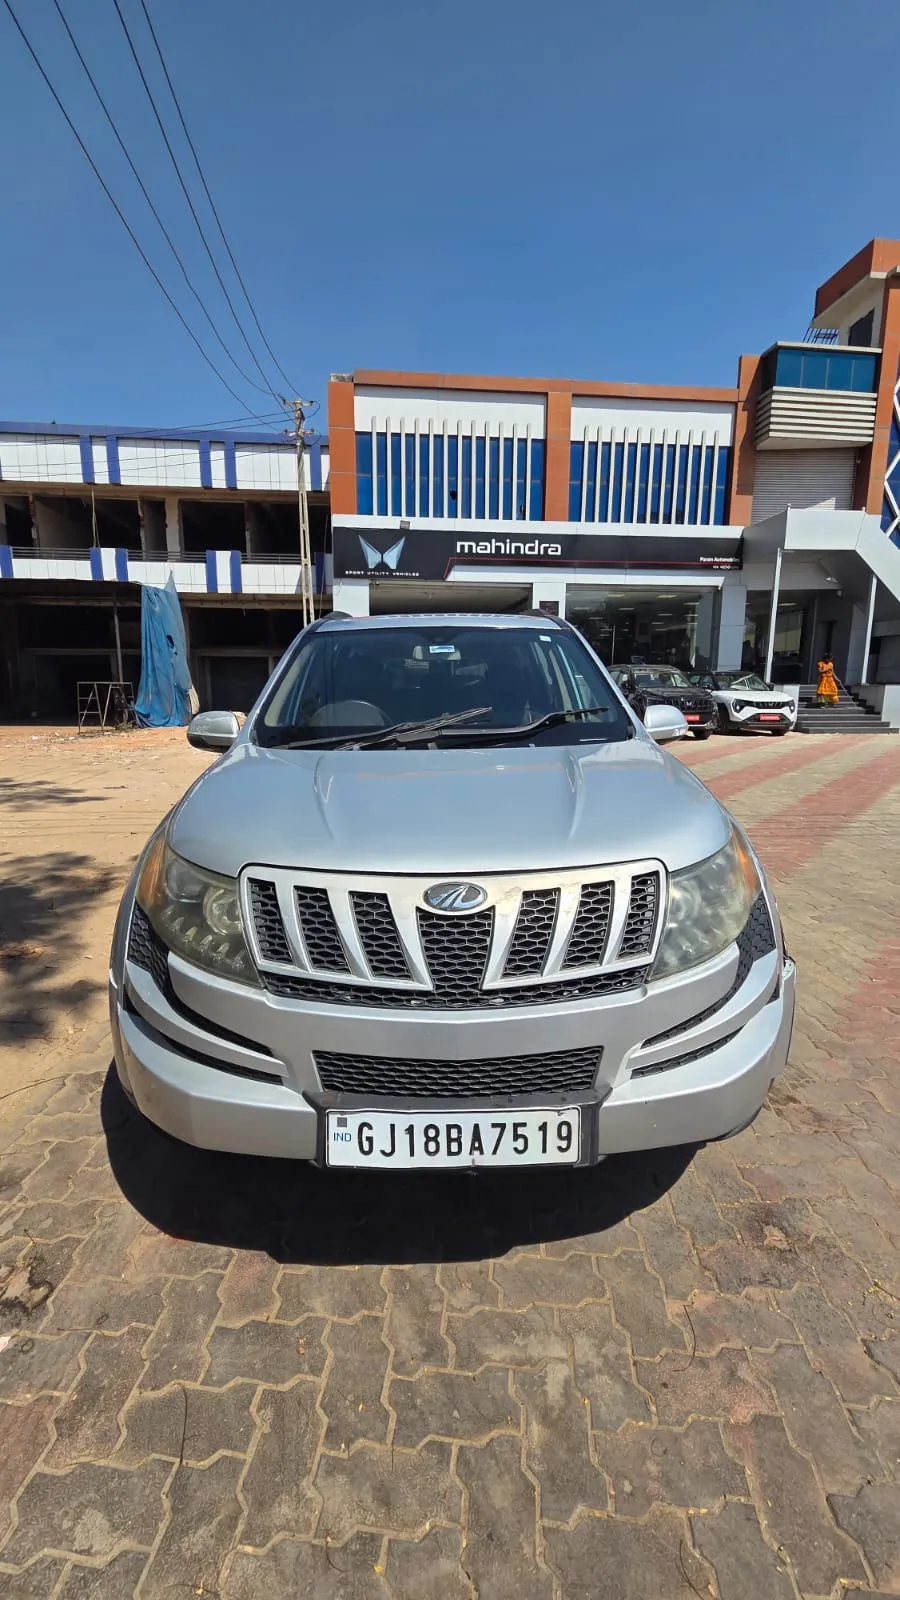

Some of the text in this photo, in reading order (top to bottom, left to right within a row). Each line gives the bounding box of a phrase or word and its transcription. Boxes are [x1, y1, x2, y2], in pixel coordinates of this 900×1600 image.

[456, 538, 561, 555] mahindra
[333, 1132, 352, 1143] IND
[357, 1121, 572, 1157] GJ18BA7519
